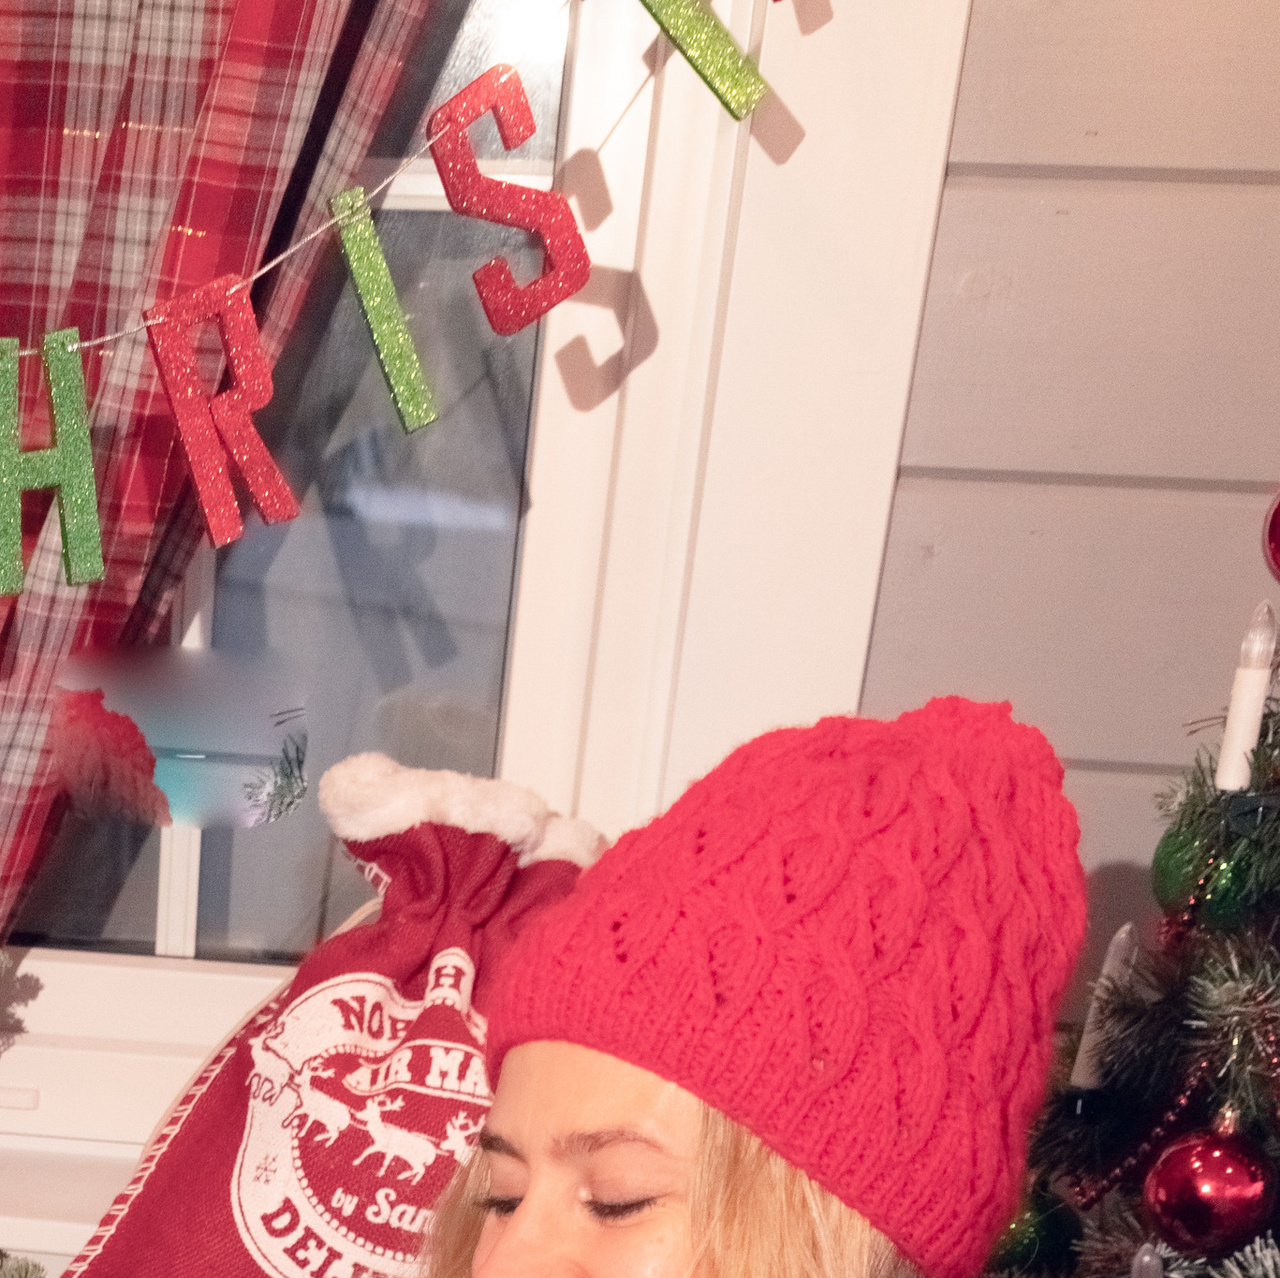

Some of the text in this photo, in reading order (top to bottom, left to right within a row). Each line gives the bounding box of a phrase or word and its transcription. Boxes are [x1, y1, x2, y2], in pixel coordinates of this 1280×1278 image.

[425, 1046, 491, 1098] MA
[331, 1187, 438, 1235] by San
